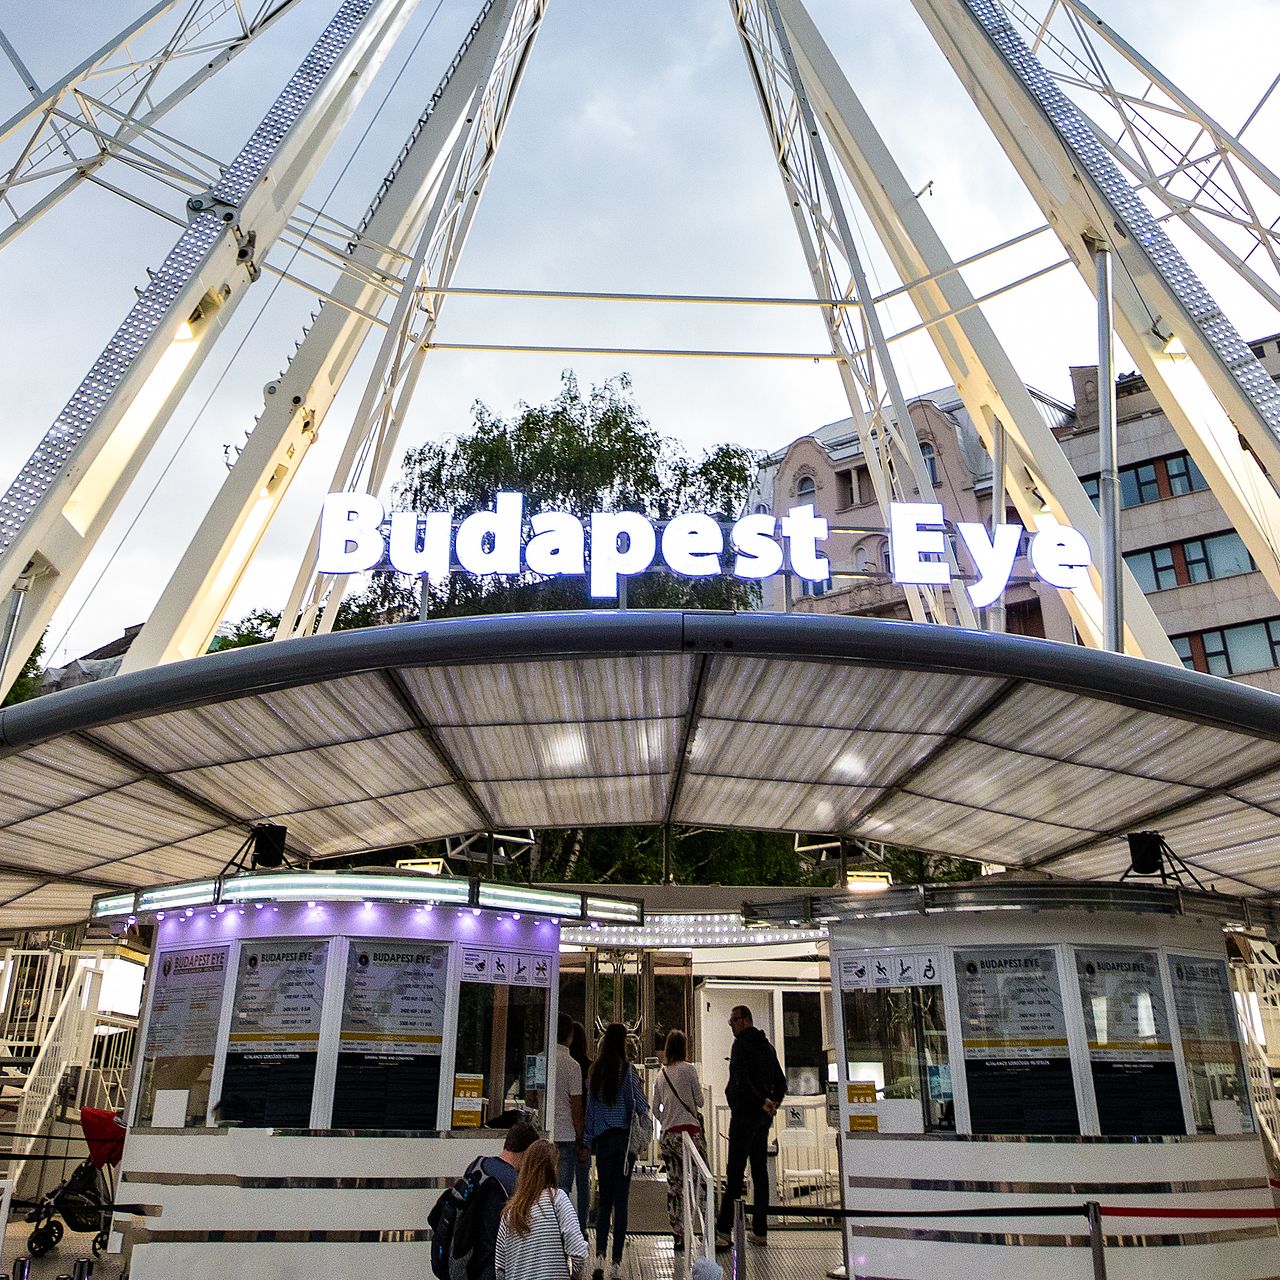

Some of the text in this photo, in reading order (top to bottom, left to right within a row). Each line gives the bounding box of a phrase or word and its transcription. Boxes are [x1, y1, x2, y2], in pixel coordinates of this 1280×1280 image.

[319, 492, 1092, 608] Budapest Eye
[211, 952, 225, 965] EYE
[261, 952, 313, 963] BUDAPEST EYE
[373, 952, 431, 964] BUDAPEST EYE
[980, 959, 1040, 969] BUDAPEST EYE
